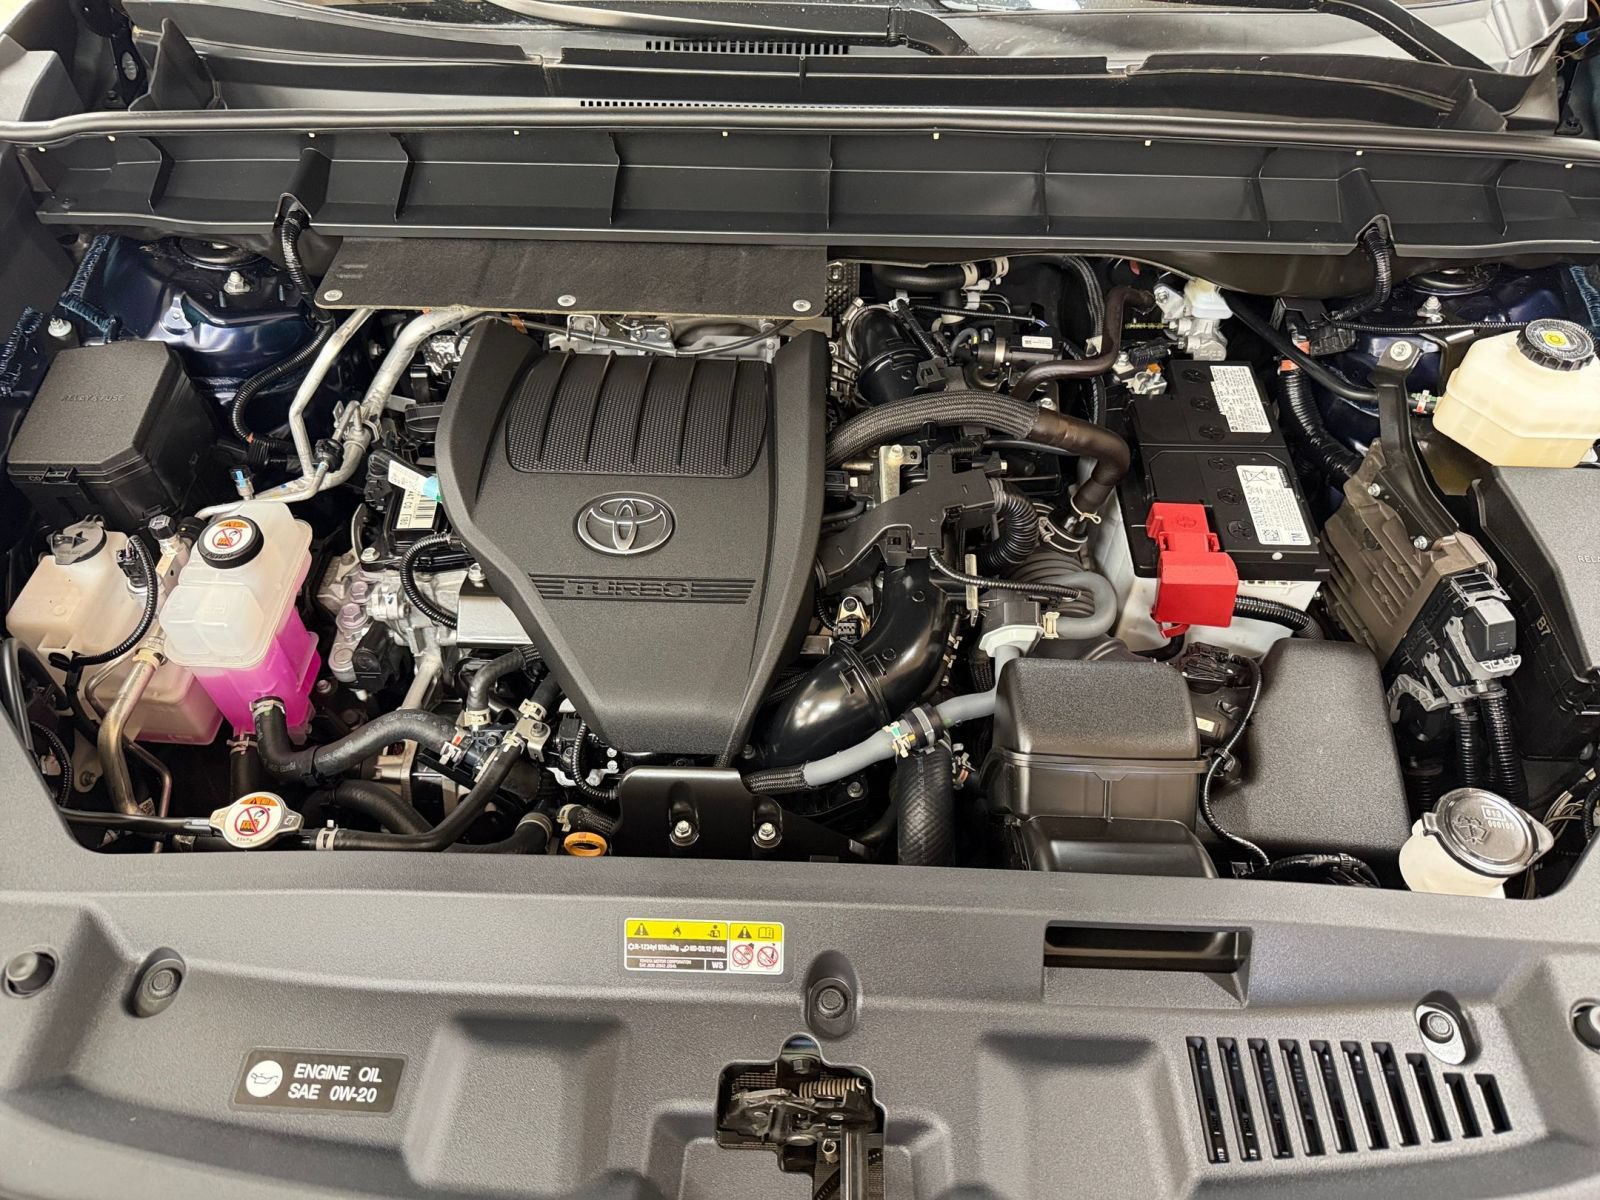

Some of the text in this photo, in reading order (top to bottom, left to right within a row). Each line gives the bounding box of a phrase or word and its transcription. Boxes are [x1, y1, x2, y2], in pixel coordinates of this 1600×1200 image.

[567, 579, 688, 597] TURBO
[1536, 615, 1551, 636] B7
[711, 961, 724, 969] WS
[293, 1063, 383, 1083] ENGINE OIL
[287, 1082, 378, 1103] SAE 0W-20
